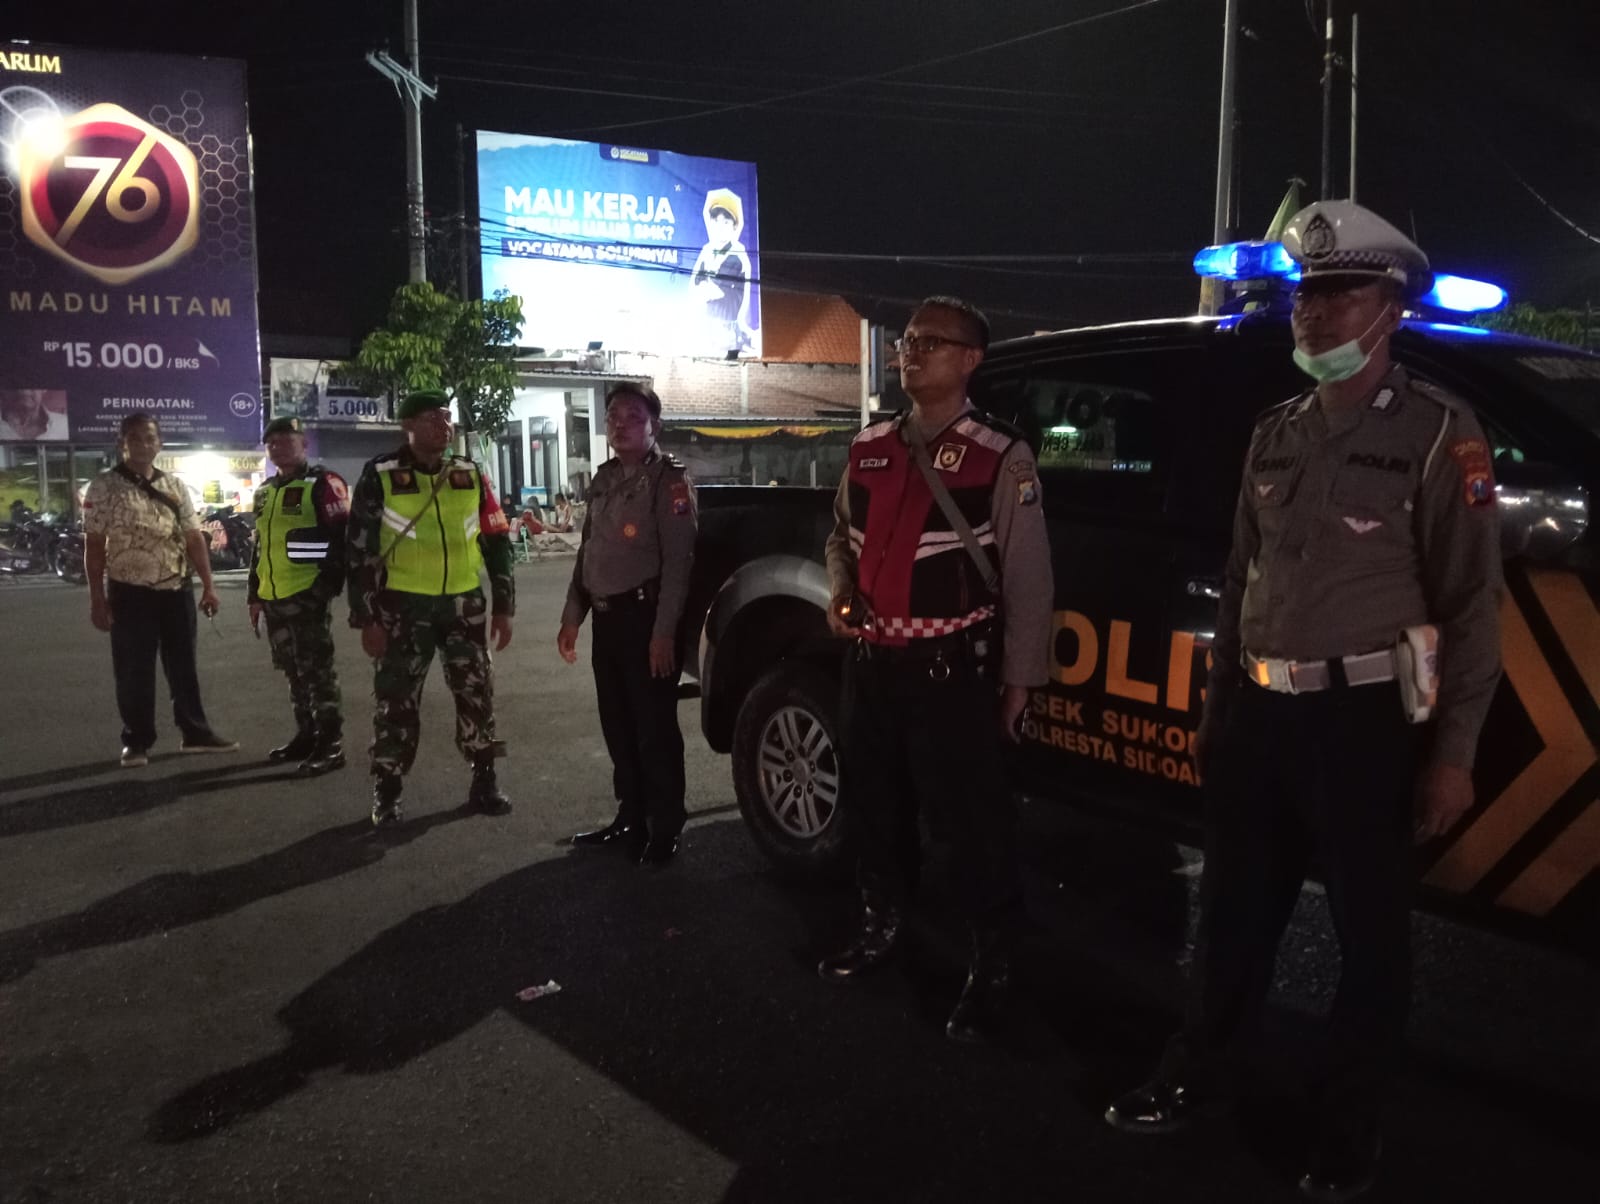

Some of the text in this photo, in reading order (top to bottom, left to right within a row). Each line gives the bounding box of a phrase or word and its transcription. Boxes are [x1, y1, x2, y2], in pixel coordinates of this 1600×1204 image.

[0, 52, 61, 73] ARUM
[54, 133, 160, 249] 76
[504, 186, 675, 224] MAU KERJA
[10, 291, 231, 317] MADU HITAM
[44, 341, 59, 352] RP
[62, 342, 164, 368] 15.000
[103, 398, 195, 409] PERINGATAN:
[233, 400, 253, 410] 18+
[328, 400, 377, 416] 5.000
[1050, 609, 1213, 712] OLI
[1033, 692, 1084, 725] SEK
[1026, 720, 1202, 787] OLRESTA SIDOA
